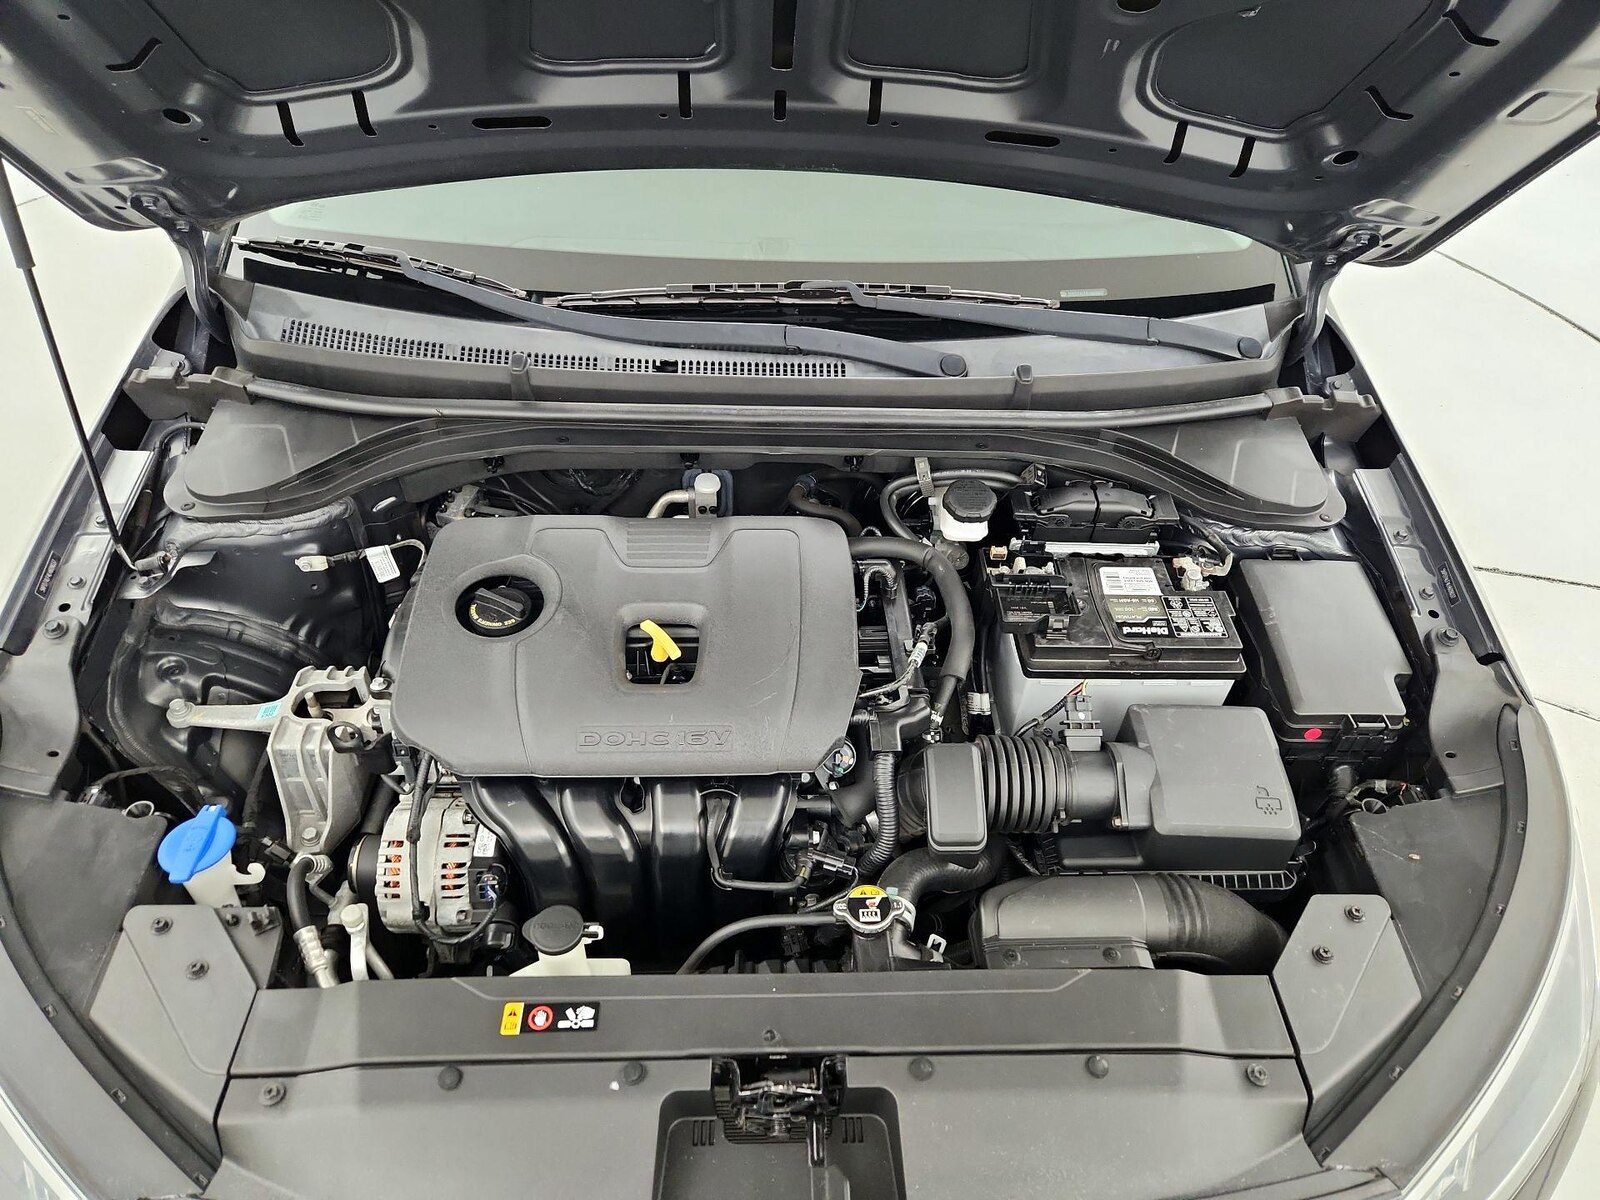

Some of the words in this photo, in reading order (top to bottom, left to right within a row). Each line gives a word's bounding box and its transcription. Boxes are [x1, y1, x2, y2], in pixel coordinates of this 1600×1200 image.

[1122, 626, 1168, 635] DieHard
[579, 731, 670, 746] DOHC
[673, 730, 732, 746] 16V
